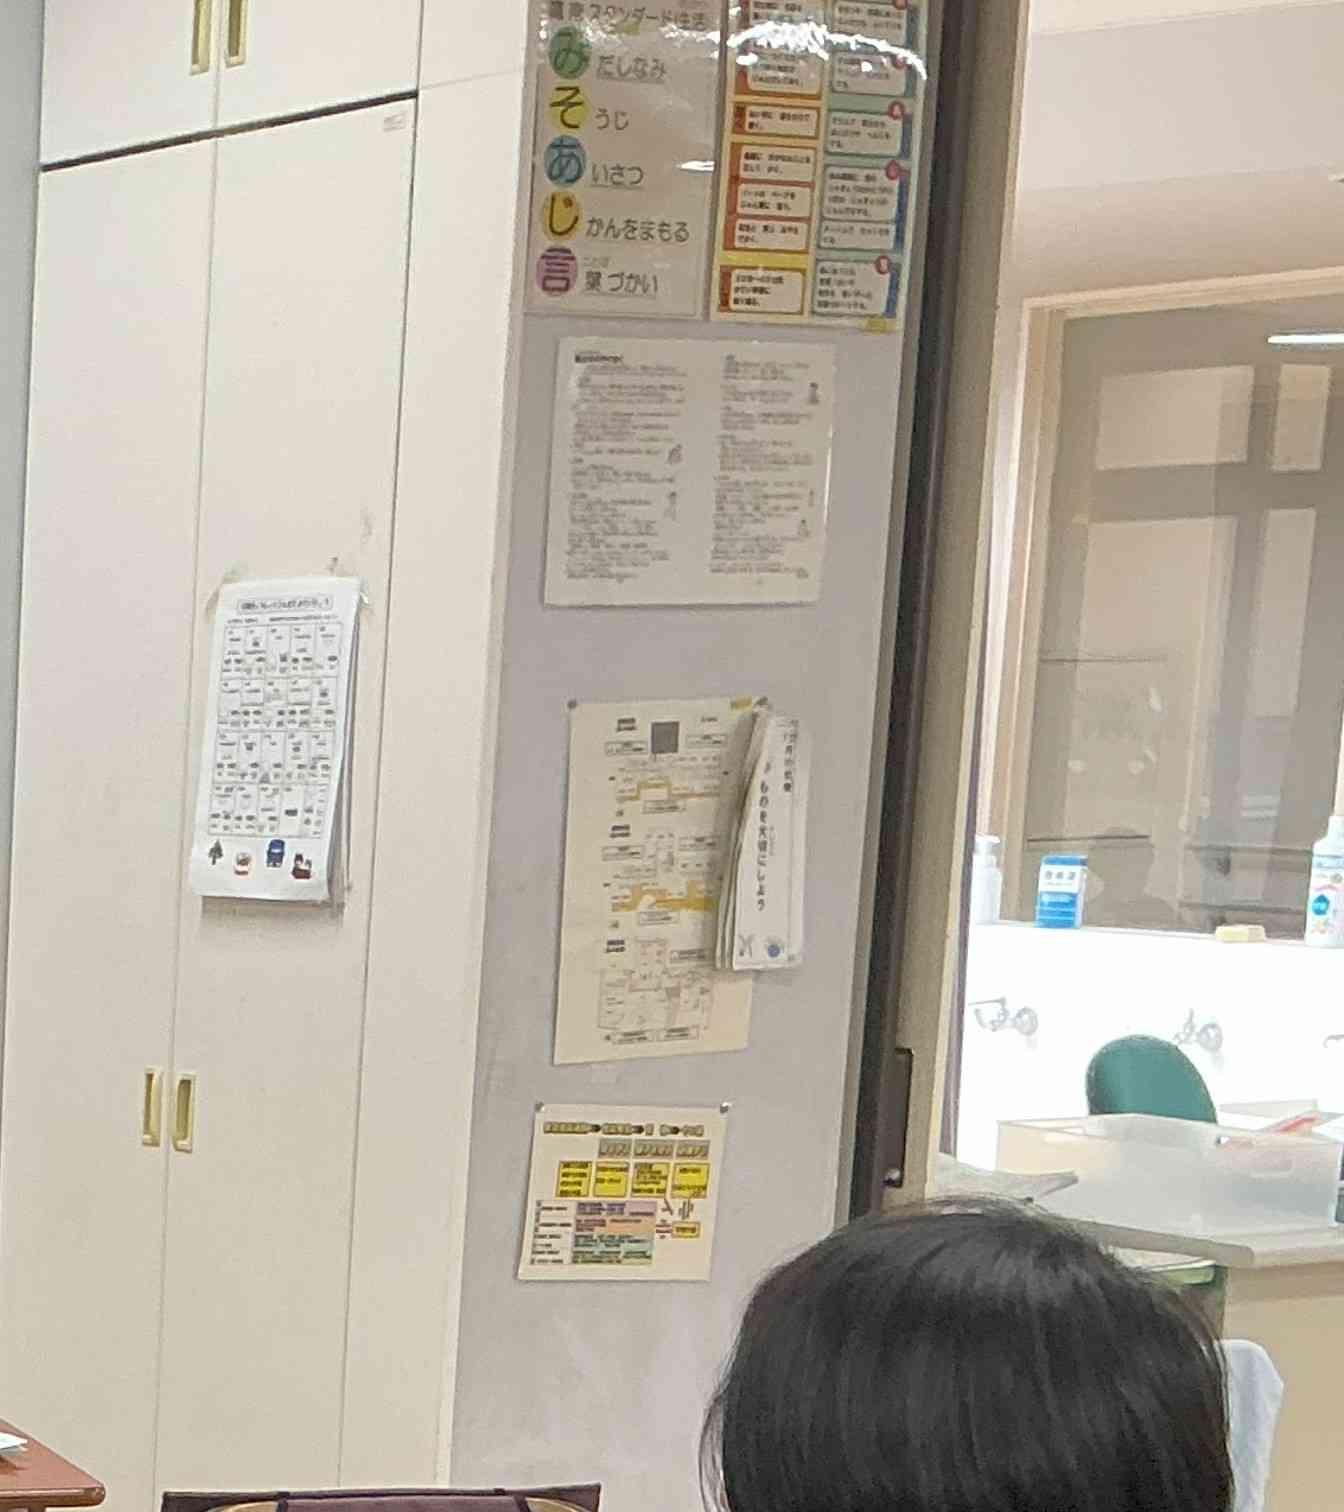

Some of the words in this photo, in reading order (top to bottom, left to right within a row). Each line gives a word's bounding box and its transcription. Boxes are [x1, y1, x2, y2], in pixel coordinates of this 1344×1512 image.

[549, 86, 629, 130] そうじ
[548, 141, 644, 184] あいさつ
[549, 193, 690, 243] じかんをまもる
[541, 248, 658, 294] 言葉づかい
